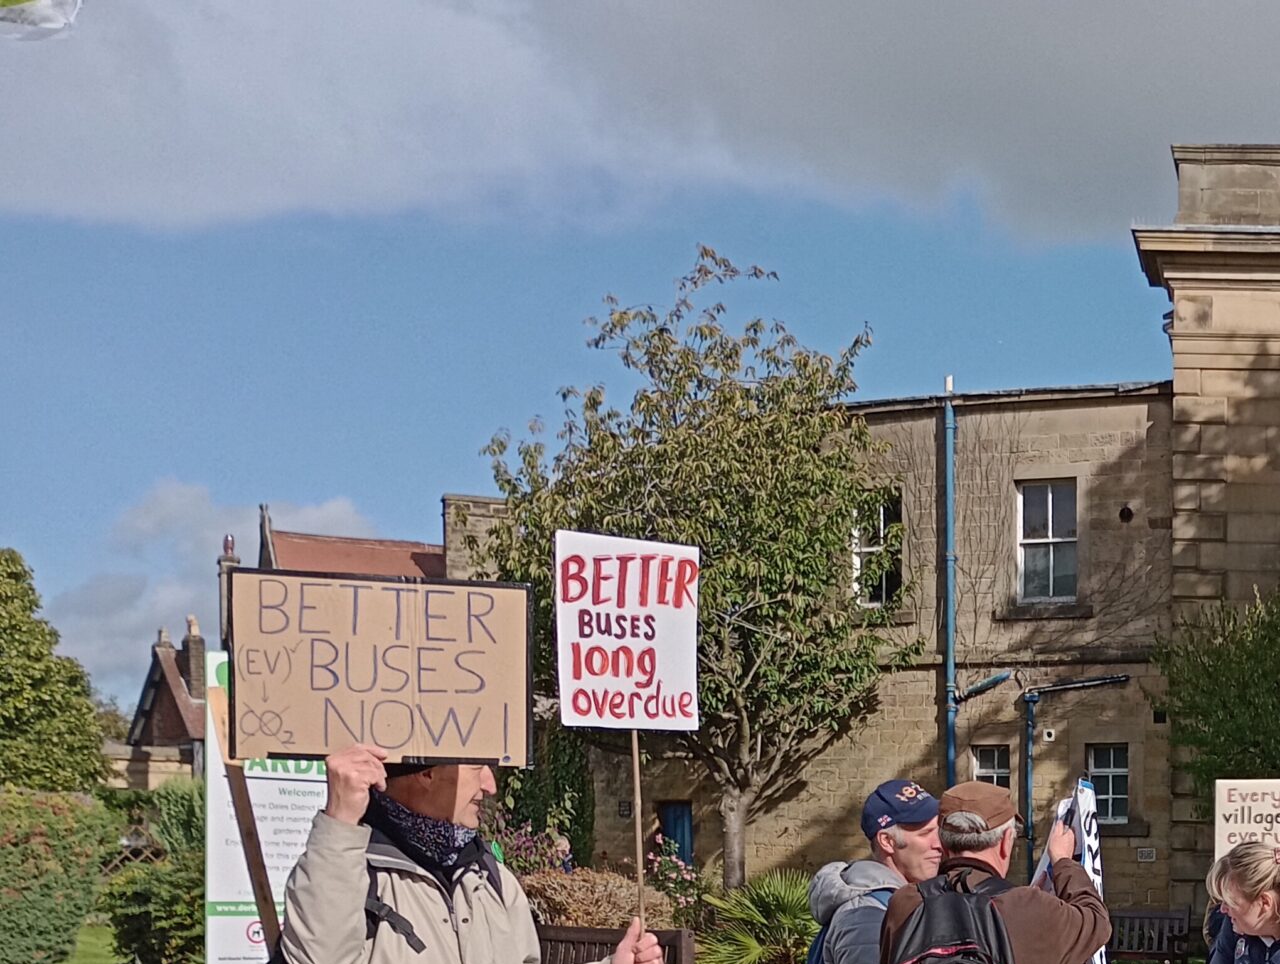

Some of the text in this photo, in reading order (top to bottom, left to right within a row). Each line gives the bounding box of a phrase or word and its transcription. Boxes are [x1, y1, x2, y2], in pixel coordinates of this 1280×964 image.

[560, 553, 700, 609] BETTER
[258, 579, 497, 644] BETTER
[578, 608, 656, 641] BUSES
[310, 637, 486, 694] BUSES
[571, 641, 657, 689] long
[571, 679, 694, 720] overdue
[278, 787, 325, 798] Welcome!
